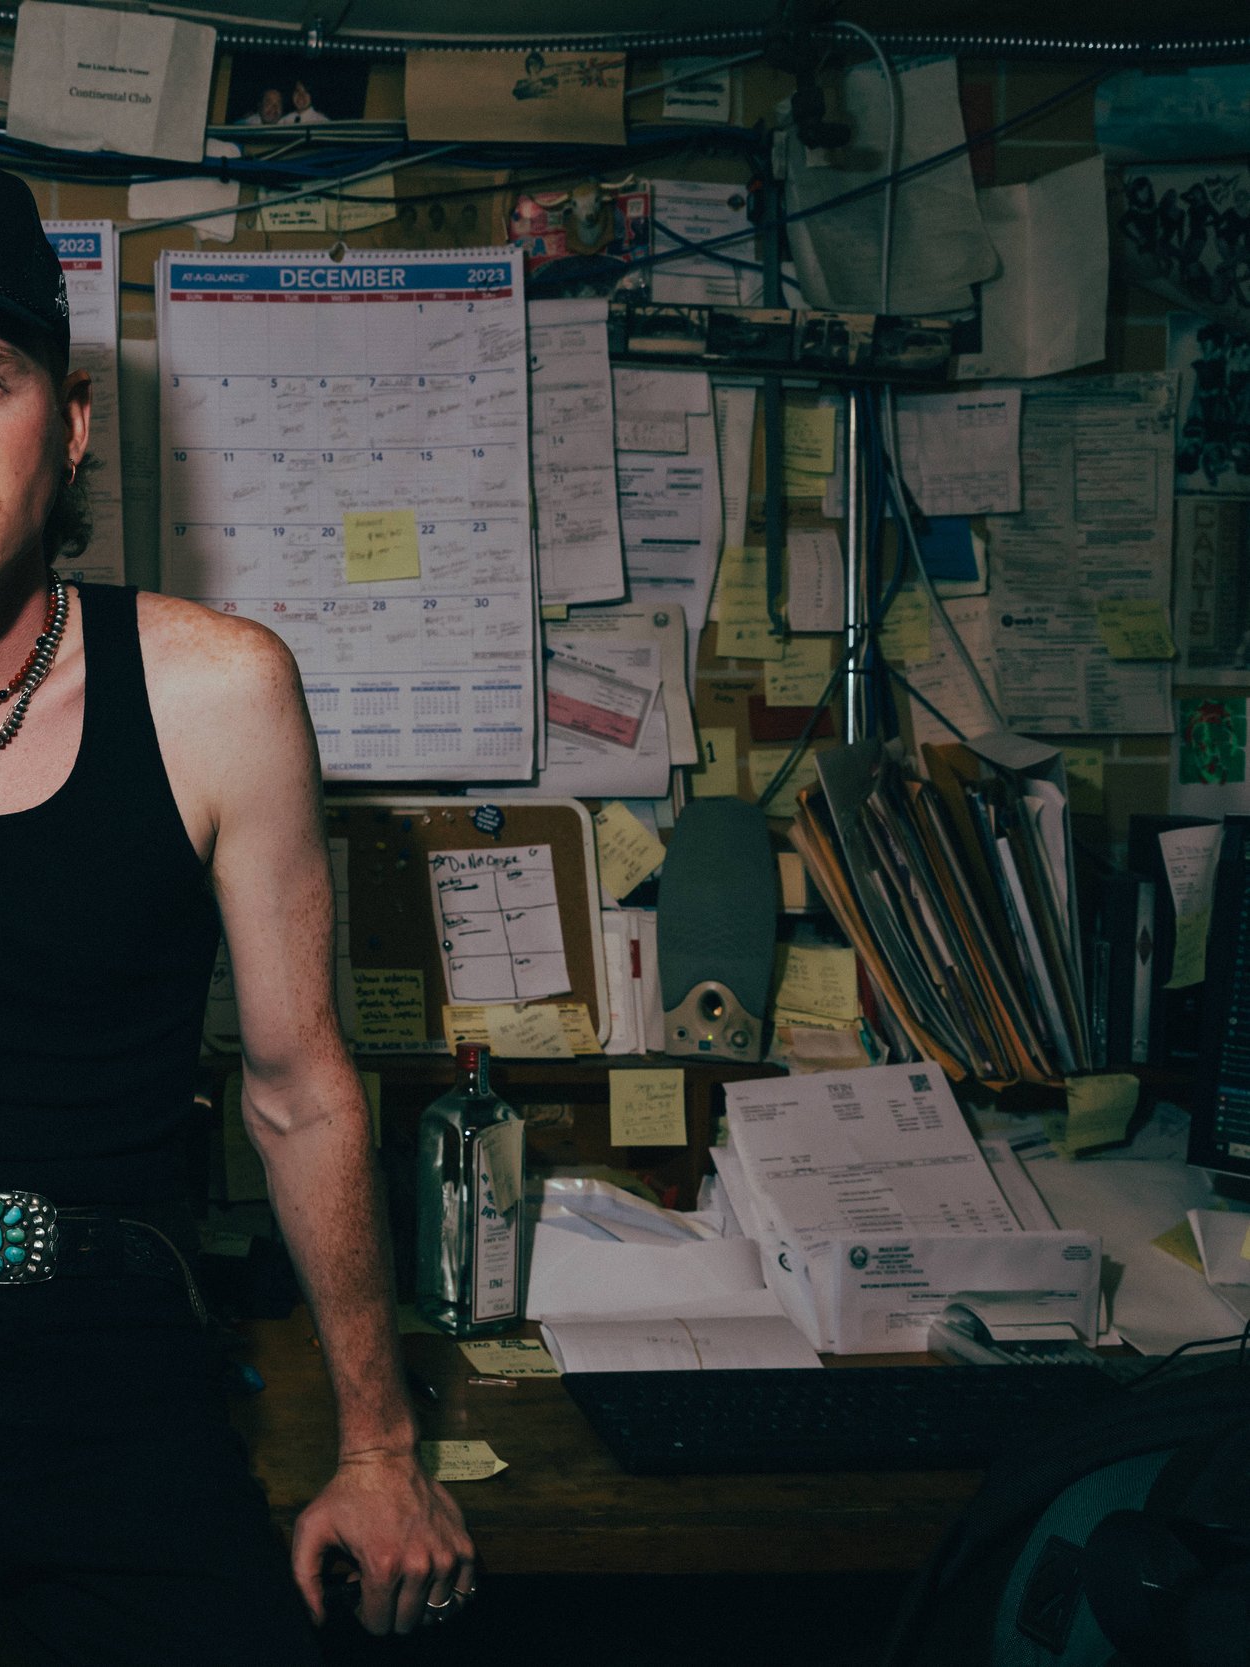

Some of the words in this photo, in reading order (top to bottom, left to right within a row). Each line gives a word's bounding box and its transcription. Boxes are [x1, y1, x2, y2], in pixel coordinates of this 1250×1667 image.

[70, 87, 126, 102] Continental
[129, 93, 152, 104] Club
[58, 239, 95, 253] 2023
[182, 273, 247, 284] AT-A-GLANCE
[279, 269, 406, 288] DECEMBER
[468, 269, 505, 284] 2023
[417, 304, 423, 313] 1
[467, 304, 474, 313] 2
[173, 378, 179, 387] 3
[222, 378, 228, 387] 4
[271, 378, 277, 387] 5
[320, 378, 327, 388] 6
[369, 378, 376, 387] 7
[418, 377, 425, 387] 8
[469, 375, 476, 384] 9
[173, 452, 187, 462] 10
[224, 452, 234, 461] 11
[272, 452, 284, 462] 12
[322, 452, 334, 462] 13
[371, 452, 383, 462] 14
[420, 451, 432, 461] 15
[472, 448, 484, 458] 16
[173, 526, 187, 537] 17
[223, 527, 236, 537] 18
[273, 527, 285, 537] 19
[322, 527, 336, 537] 20
[422, 525, 435, 535] 22
[473, 522, 487, 532] 23
[223, 602, 236, 612] 25
[273, 602, 286, 612] 26
[323, 602, 336, 612] 27
[372, 601, 386, 611] 28
[423, 599, 437, 609] 29
[474, 598, 488, 608] 30
